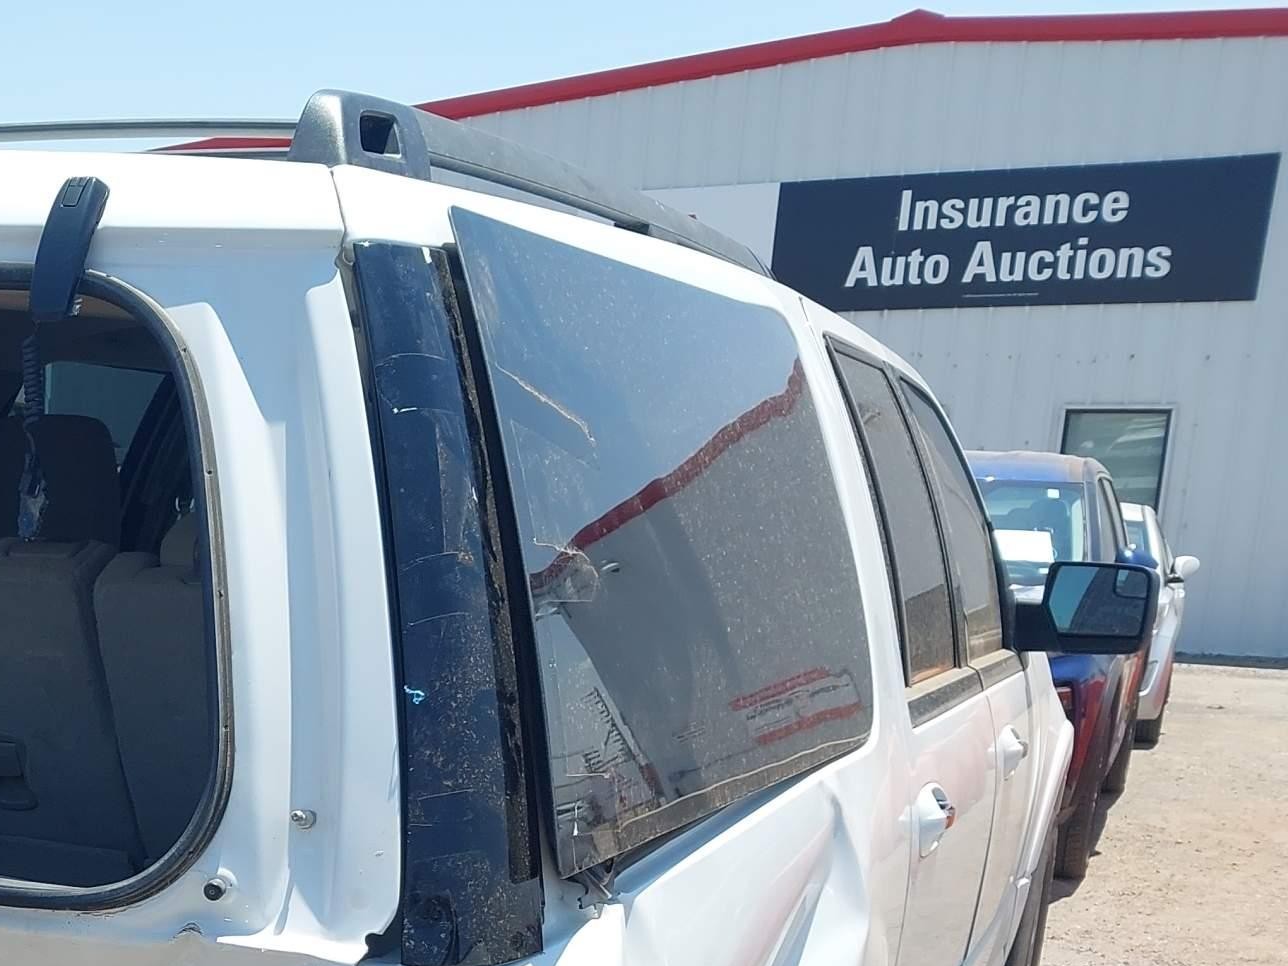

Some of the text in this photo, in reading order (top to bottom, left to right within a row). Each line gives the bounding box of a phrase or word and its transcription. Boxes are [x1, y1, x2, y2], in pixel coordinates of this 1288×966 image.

[897, 189, 1131, 231] Insurance
[844, 237, 1173, 288] Auto Auctions
